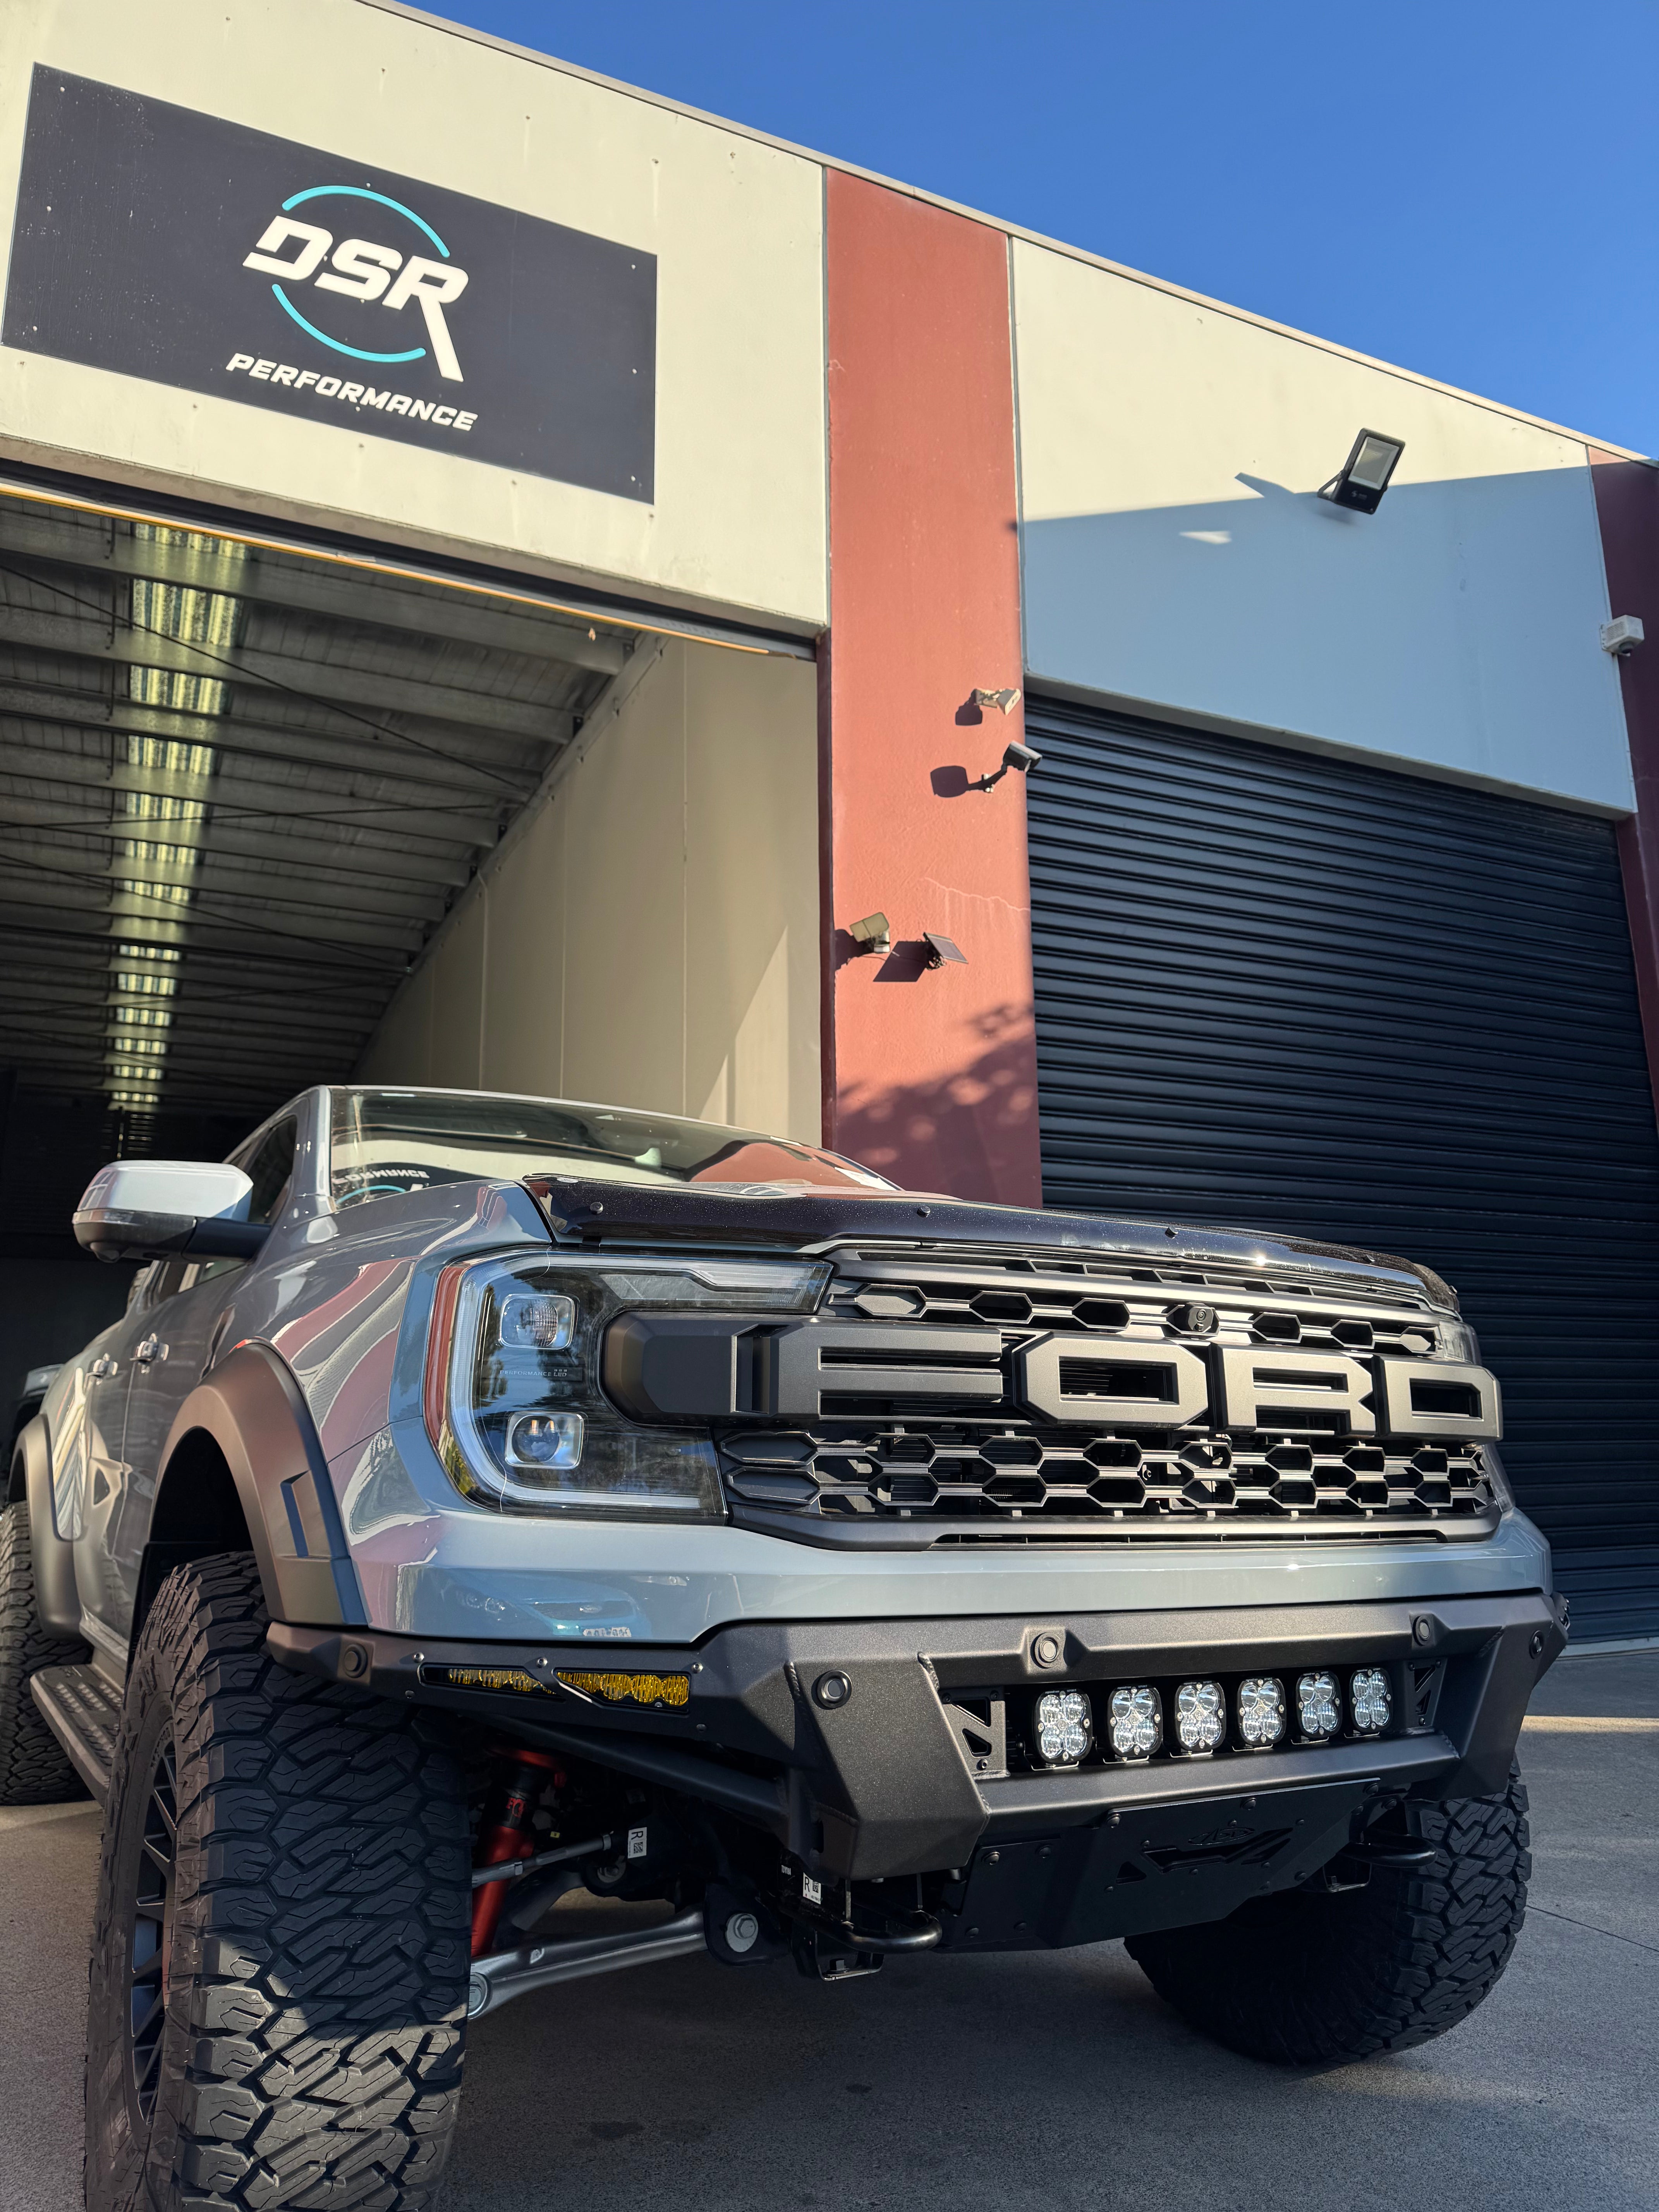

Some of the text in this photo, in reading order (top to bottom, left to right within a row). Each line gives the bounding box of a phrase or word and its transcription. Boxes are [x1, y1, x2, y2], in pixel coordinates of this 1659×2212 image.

[242, 214, 469, 382] DSR
[226, 352, 478, 433] PERFORMANCE
[776, 1322, 1503, 1443] FORD
[505, 1797, 524, 1819] FO
[805, 1876, 810, 1892] R
